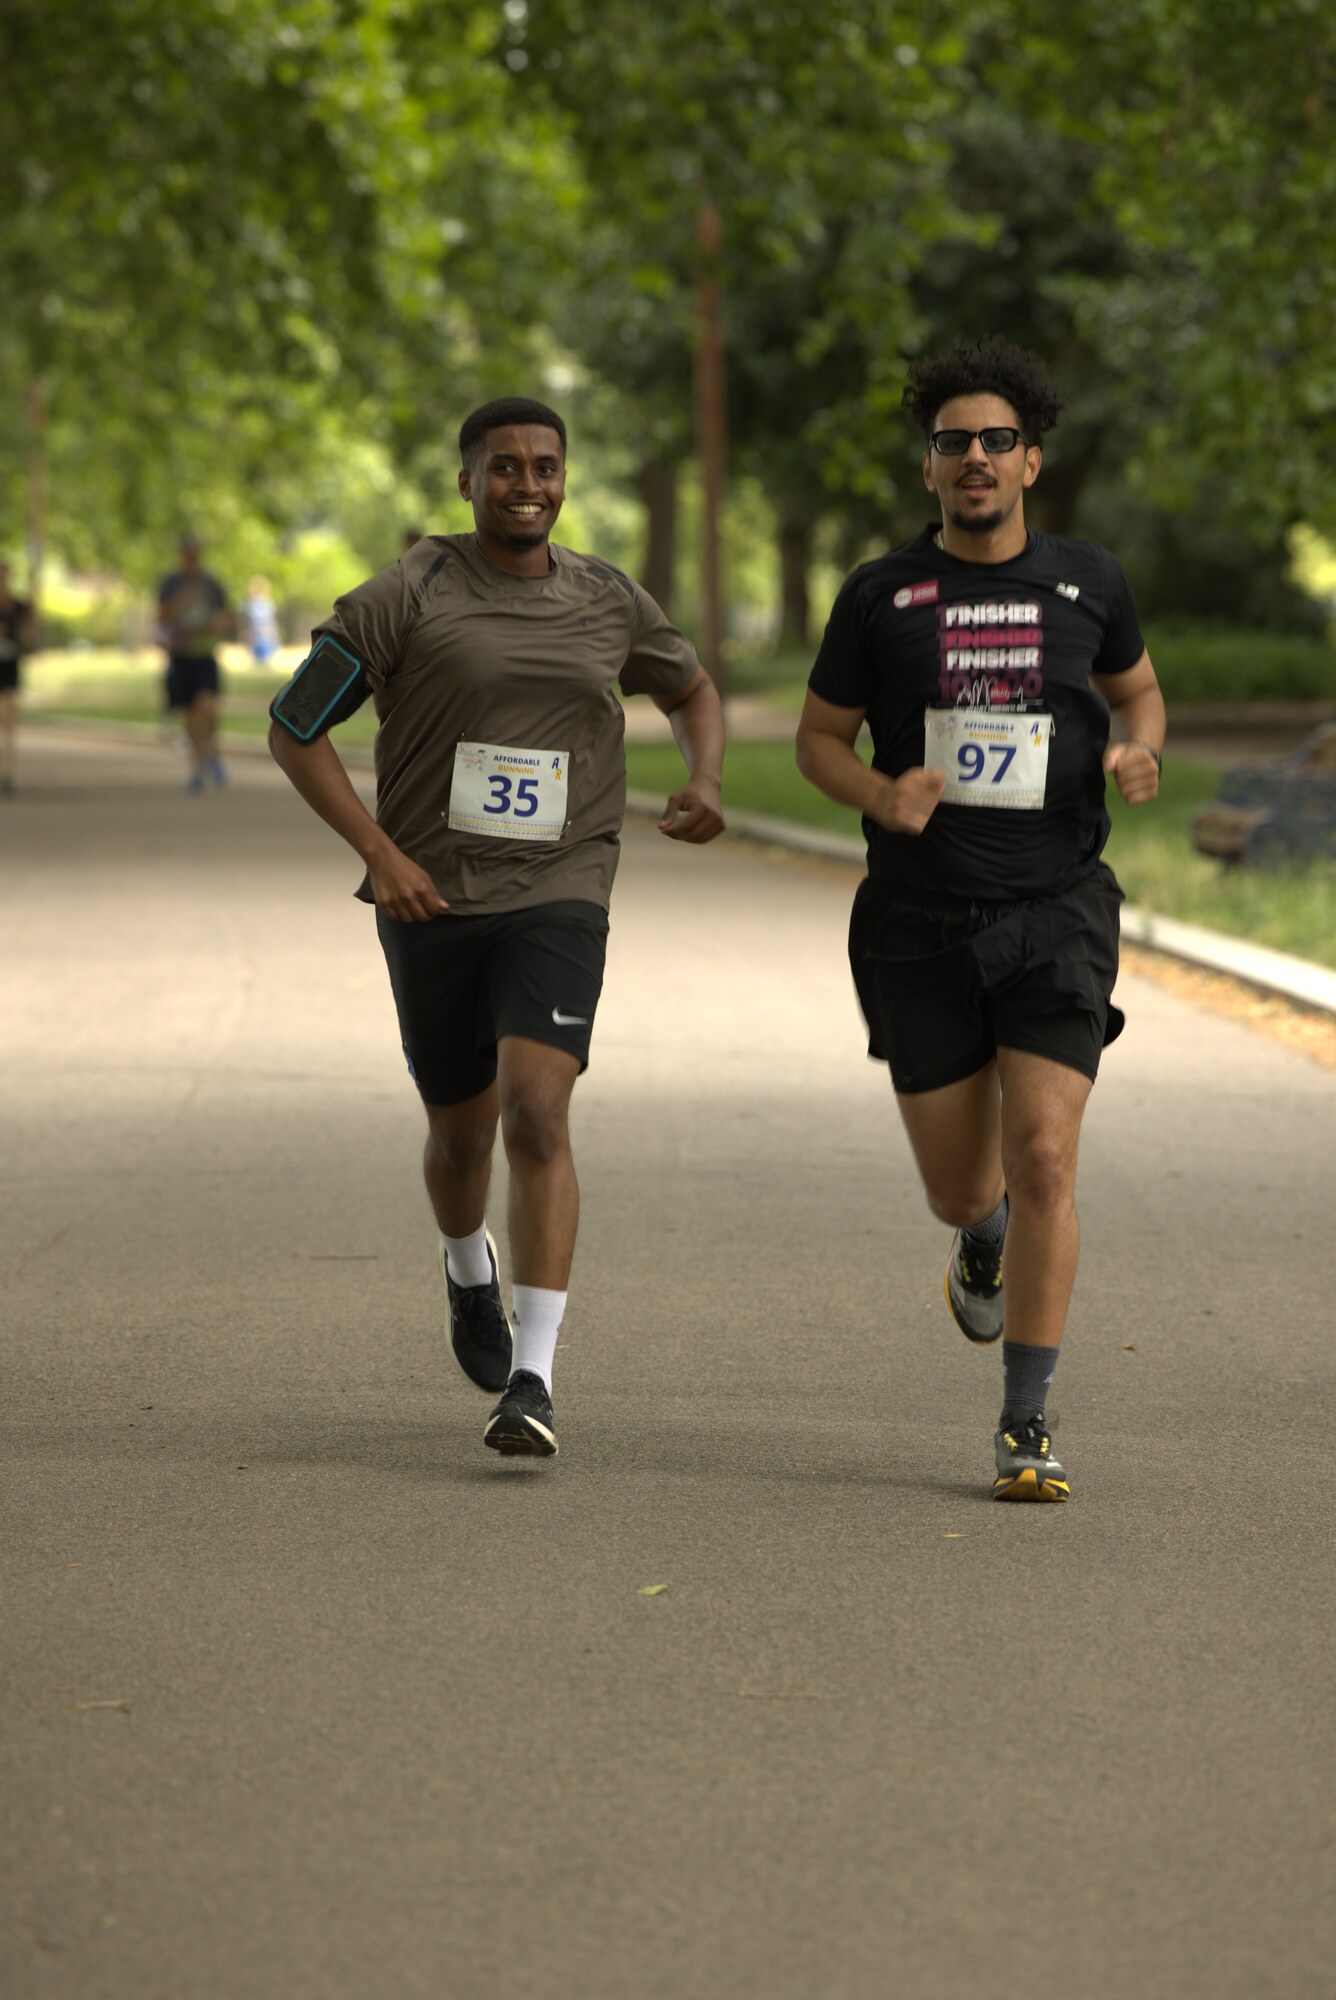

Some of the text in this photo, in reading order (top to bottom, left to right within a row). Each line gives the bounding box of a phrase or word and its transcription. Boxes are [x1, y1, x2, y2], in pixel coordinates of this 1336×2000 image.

[946, 604, 1039, 627] FINISHER
[946, 628, 1039, 648] FINISHER
[946, 647, 1039, 671] FINISHER
[965, 721, 1015, 732] AFFORDABLE
[494, 755, 540, 766] AFFORDABLE
[552, 757, 559, 769] A
[957, 743, 1017, 784] 97
[498, 765, 535, 775] RUNNING
[555, 768, 562, 781] R
[483, 775, 539, 817] 35
